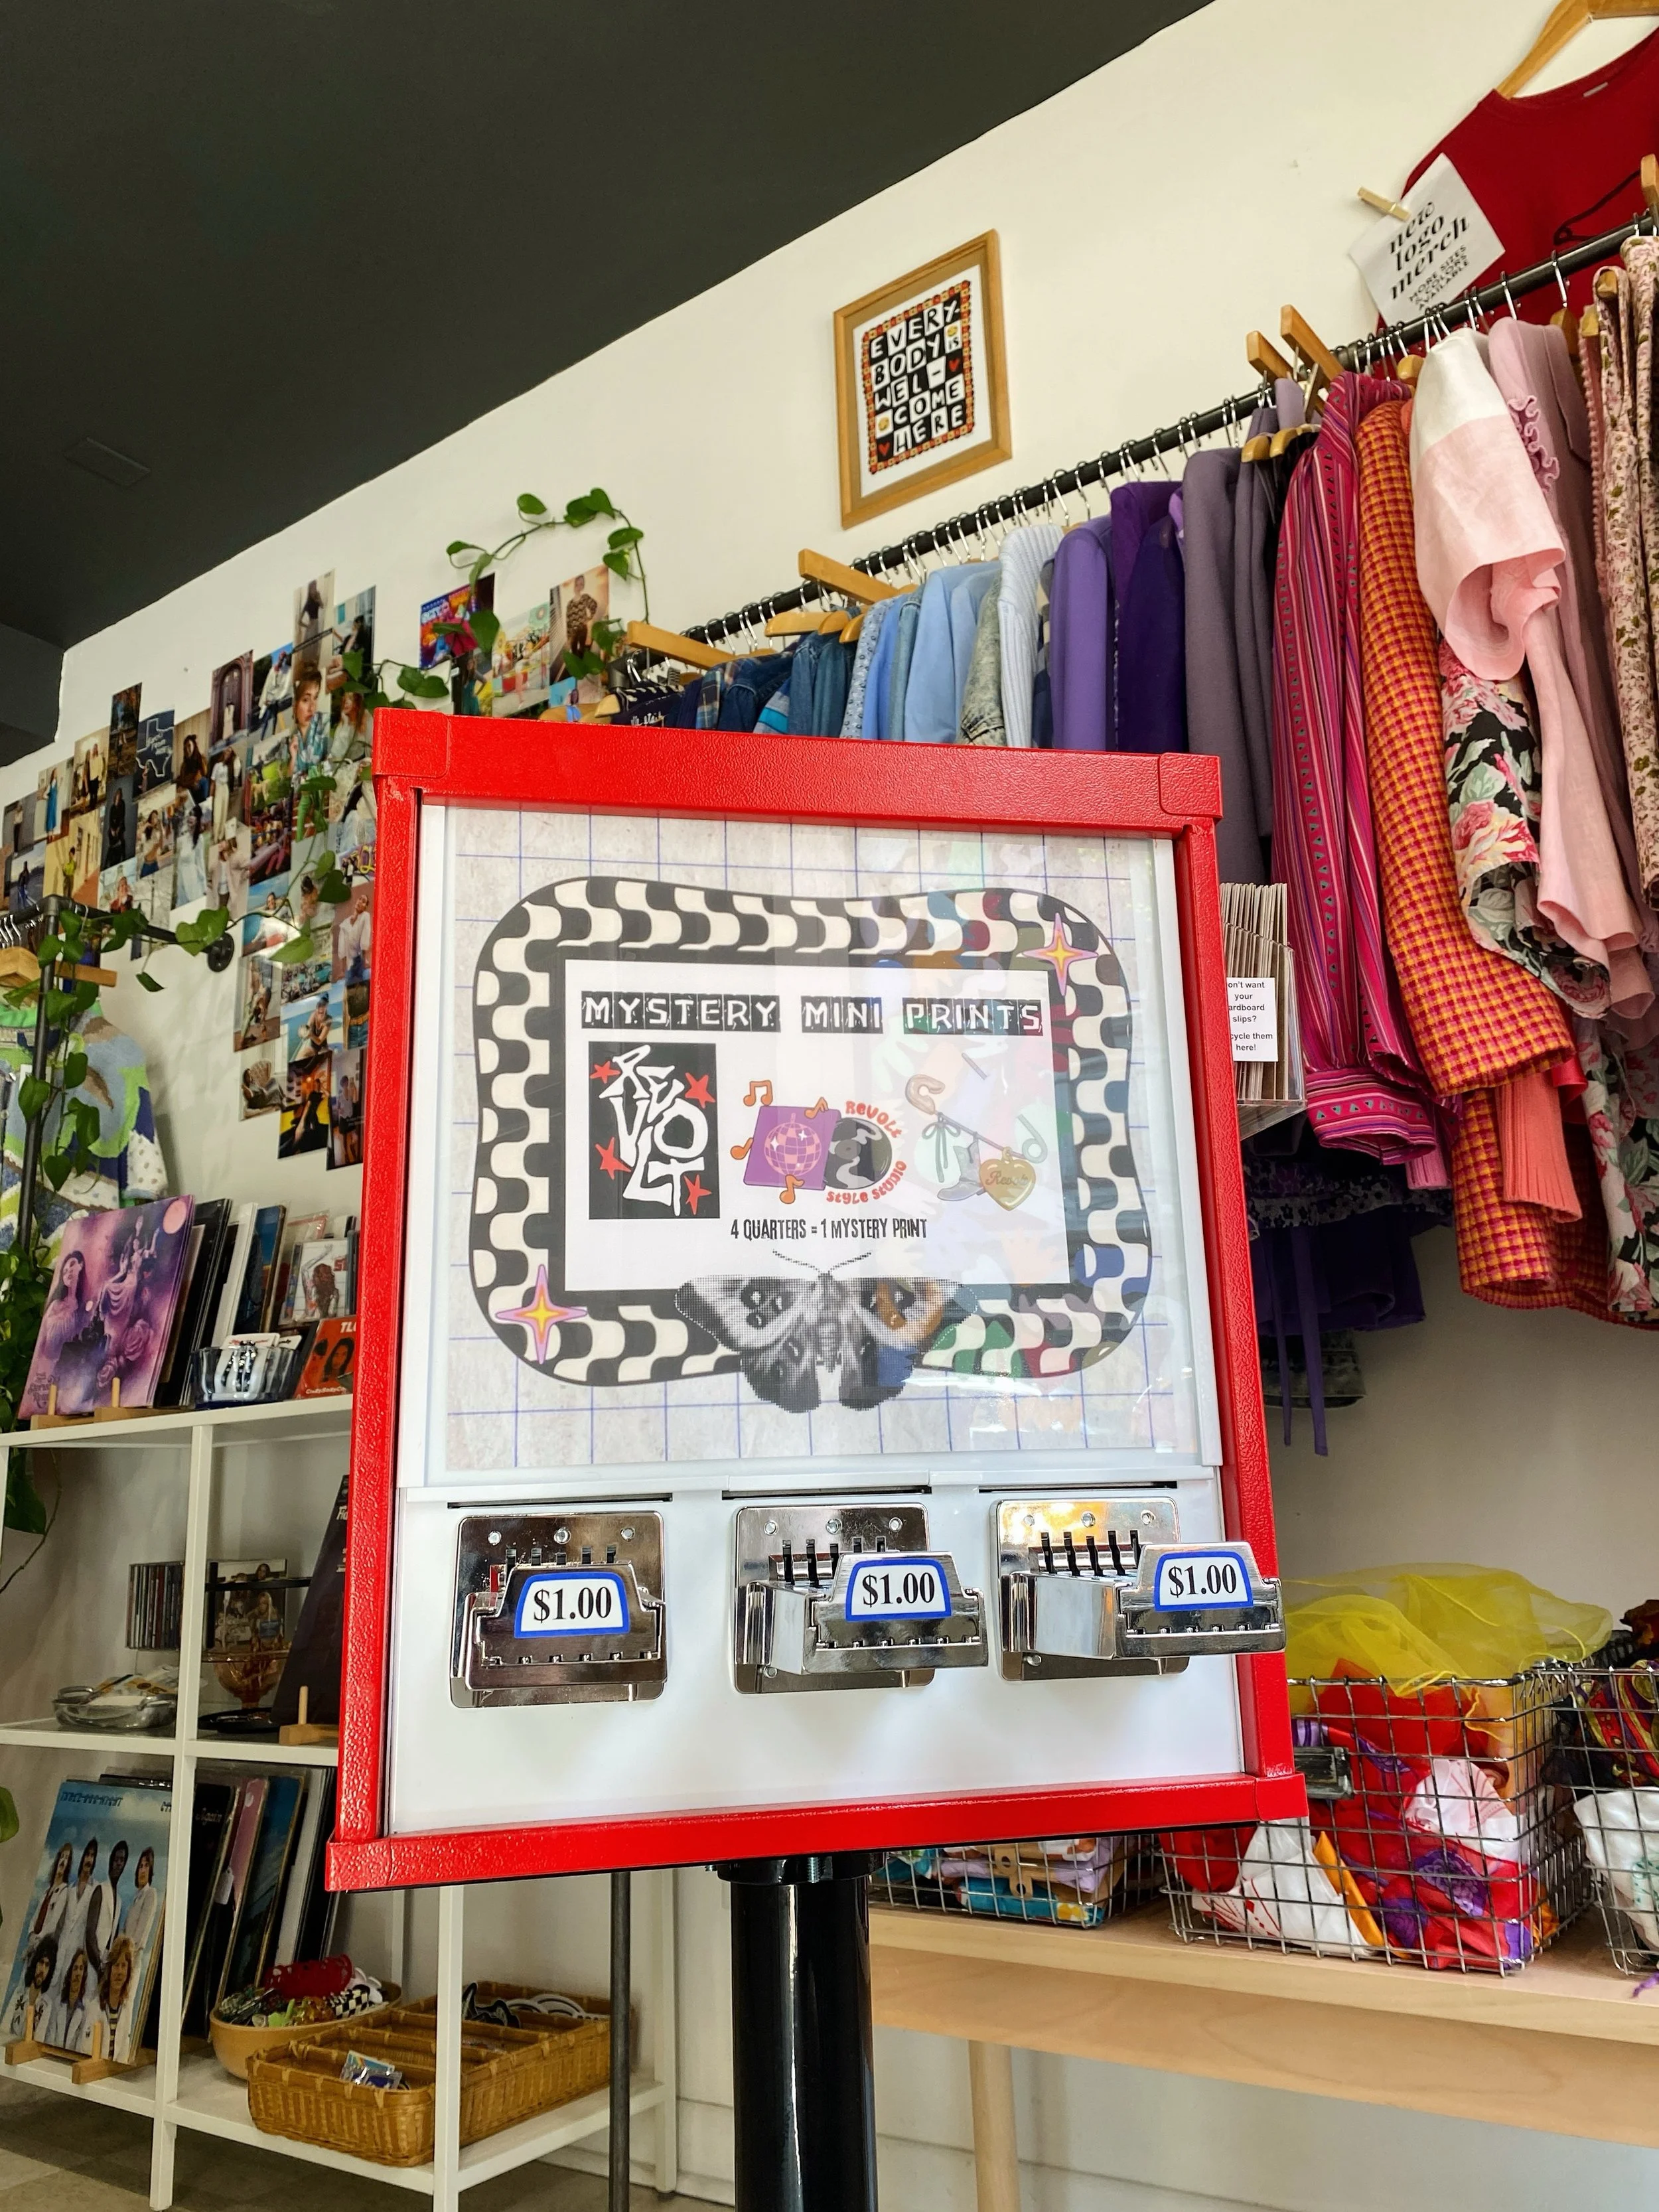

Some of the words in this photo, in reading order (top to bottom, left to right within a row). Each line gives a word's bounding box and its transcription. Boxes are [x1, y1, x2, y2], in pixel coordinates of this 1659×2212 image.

[1390, 201, 1435, 254] new
[1396, 215, 1444, 271] logo
[1392, 216, 1469, 299] merch
[1409, 271, 1438, 302] MORE
[1441, 244, 1467, 271] SIZES
[1425, 254, 1467, 294] COLORS
[875, 333, 940, 381] BODY
[875, 369, 941, 411] WEL-
[894, 380, 960, 425] COME
[896, 404, 964, 453] HERE
[585, 997, 776, 1027] MYSTERY
[805, 1001, 880, 1028] MINI
[905, 1003, 1040, 1029] PRINTS
[599, 1044, 709, 1217] REVOLT
[731, 1218, 739, 1239] 4
[743, 1218, 806, 1241] QUARTERS
[820, 1218, 827, 1238] 1
[831, 1218, 888, 1239] MYSTERY
[893, 1218, 927, 1239] PRINT
[862, 1572, 935, 1609] $1.00
[1167, 1564, 1237, 1598] $1.00
[533, 1585, 612, 1624] $1.00
